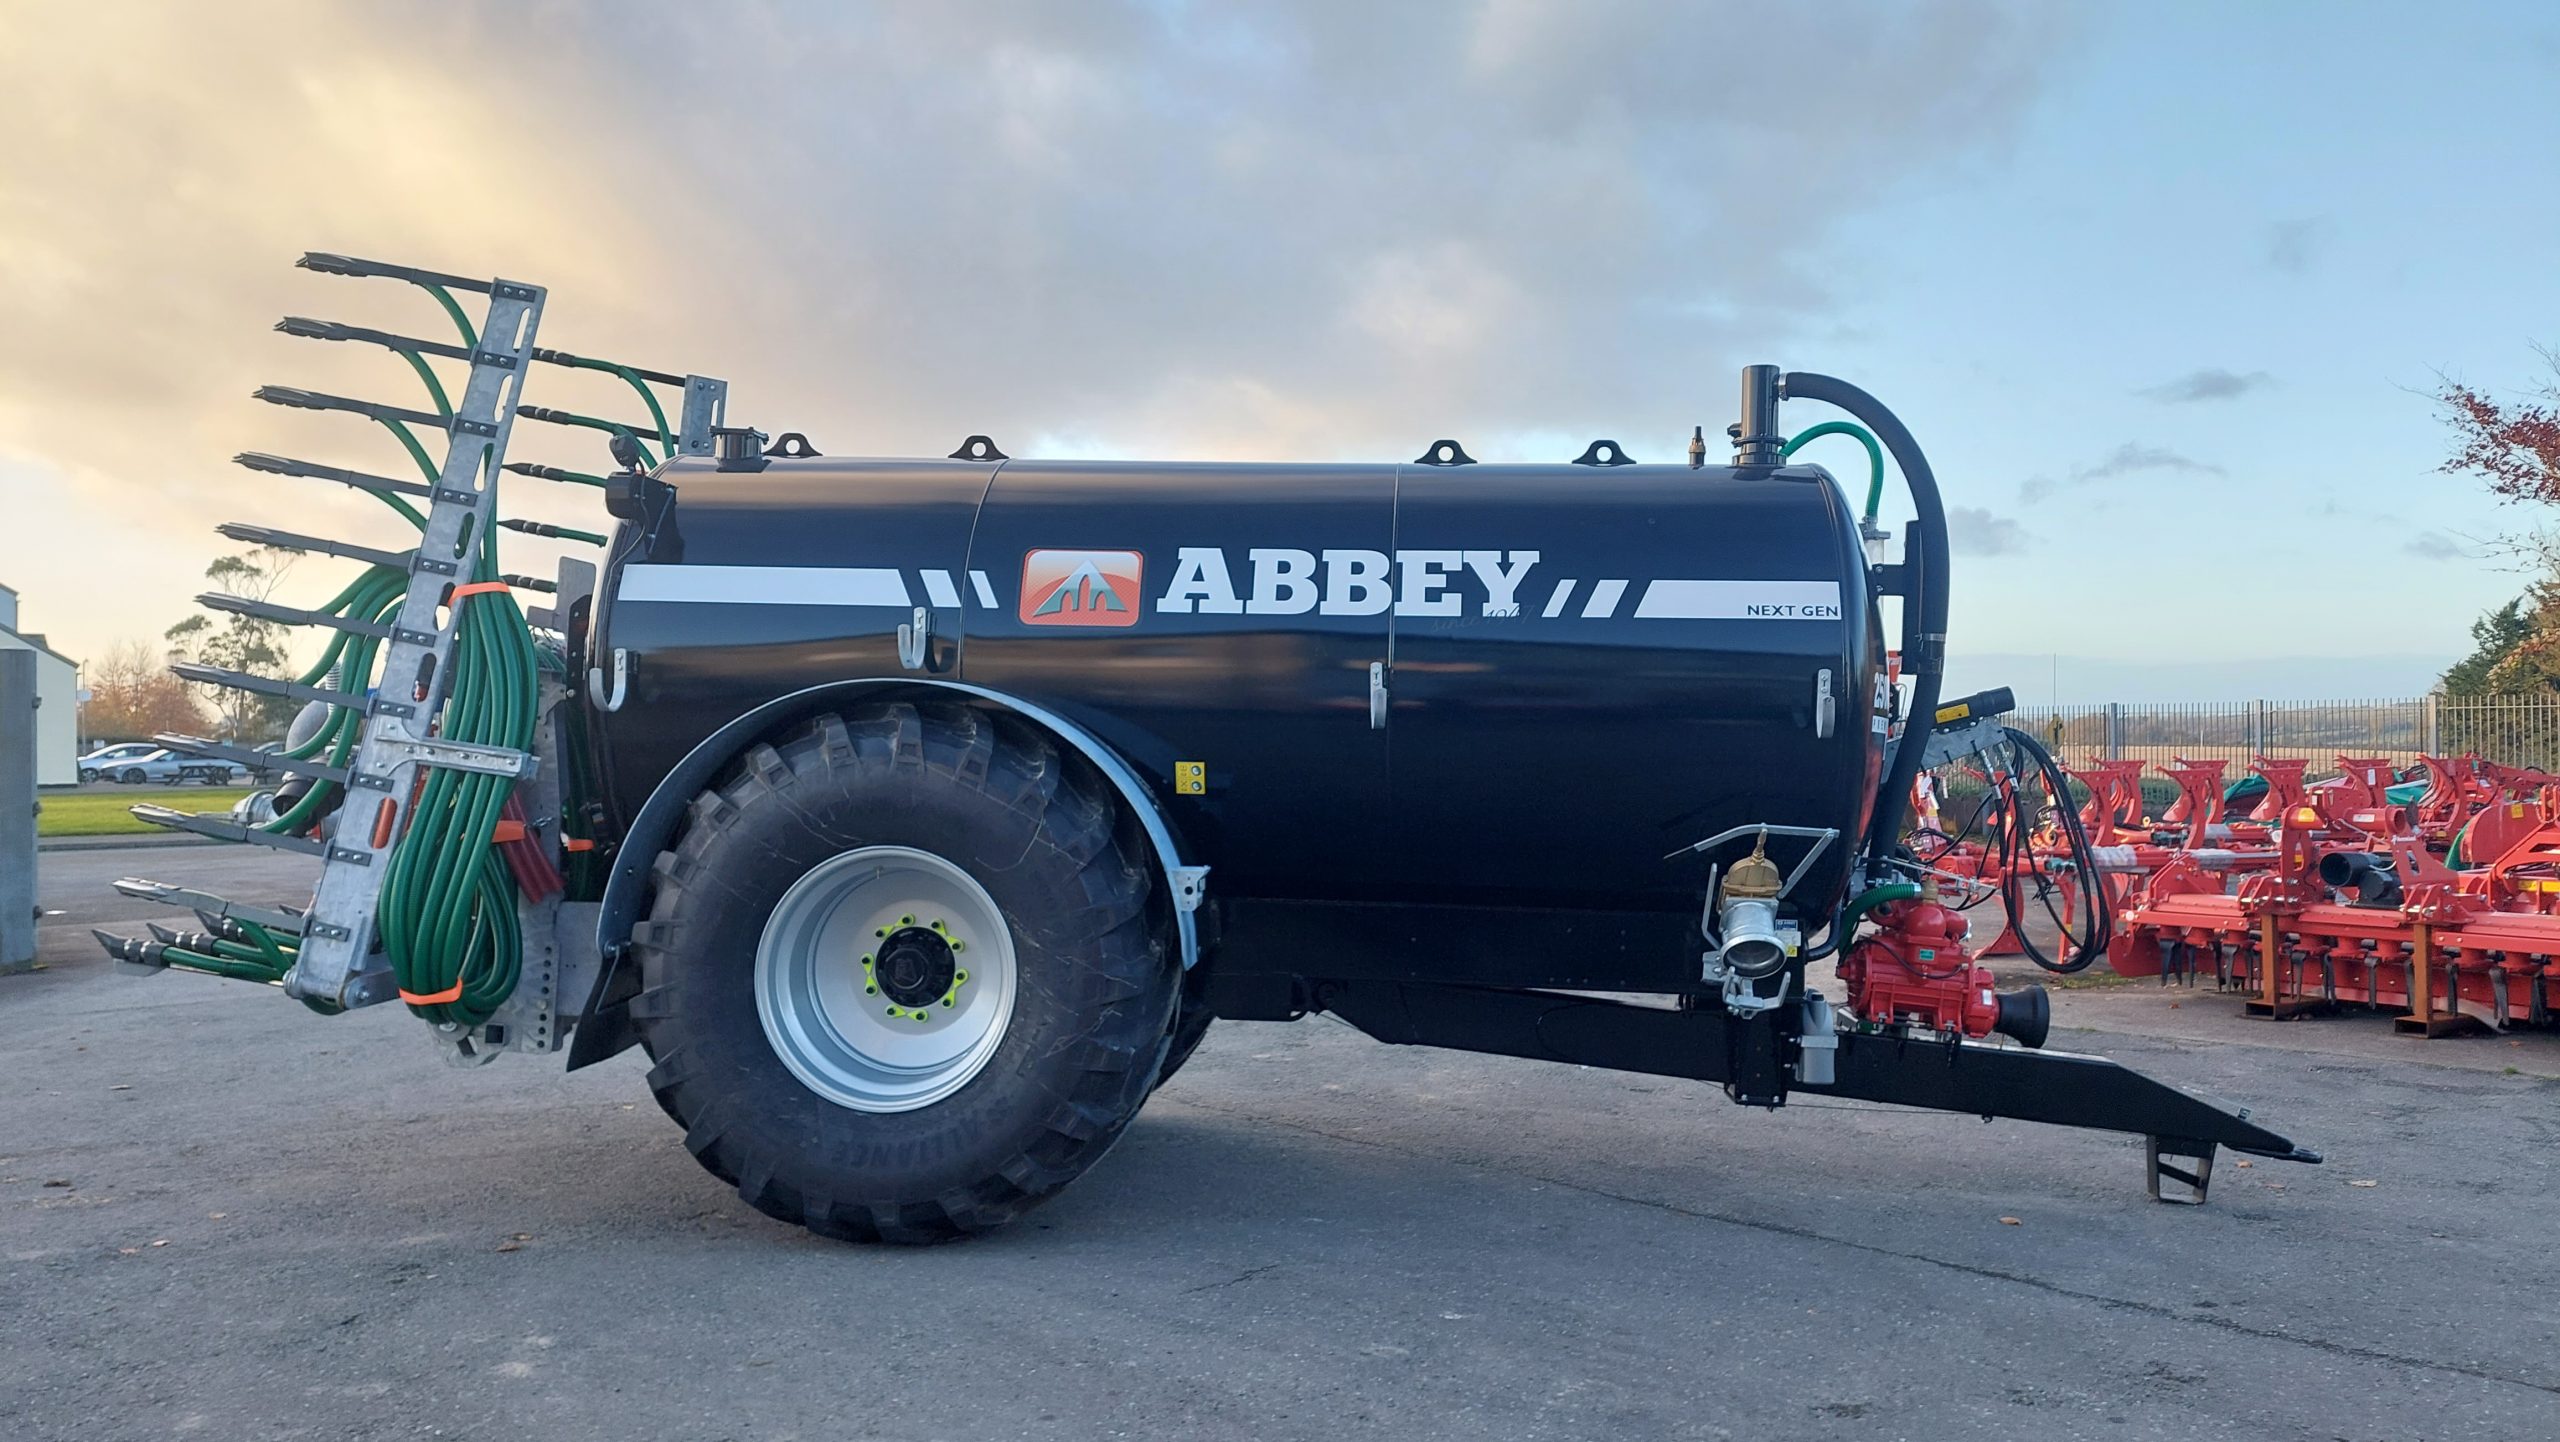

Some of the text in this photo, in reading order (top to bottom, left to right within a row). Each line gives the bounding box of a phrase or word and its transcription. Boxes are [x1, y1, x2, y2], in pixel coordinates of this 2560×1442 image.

[1156, 547, 1540, 618] ABBEY
[1486, 604, 1536, 625] 1947
[1747, 604, 1838, 617] NEXT GEN
